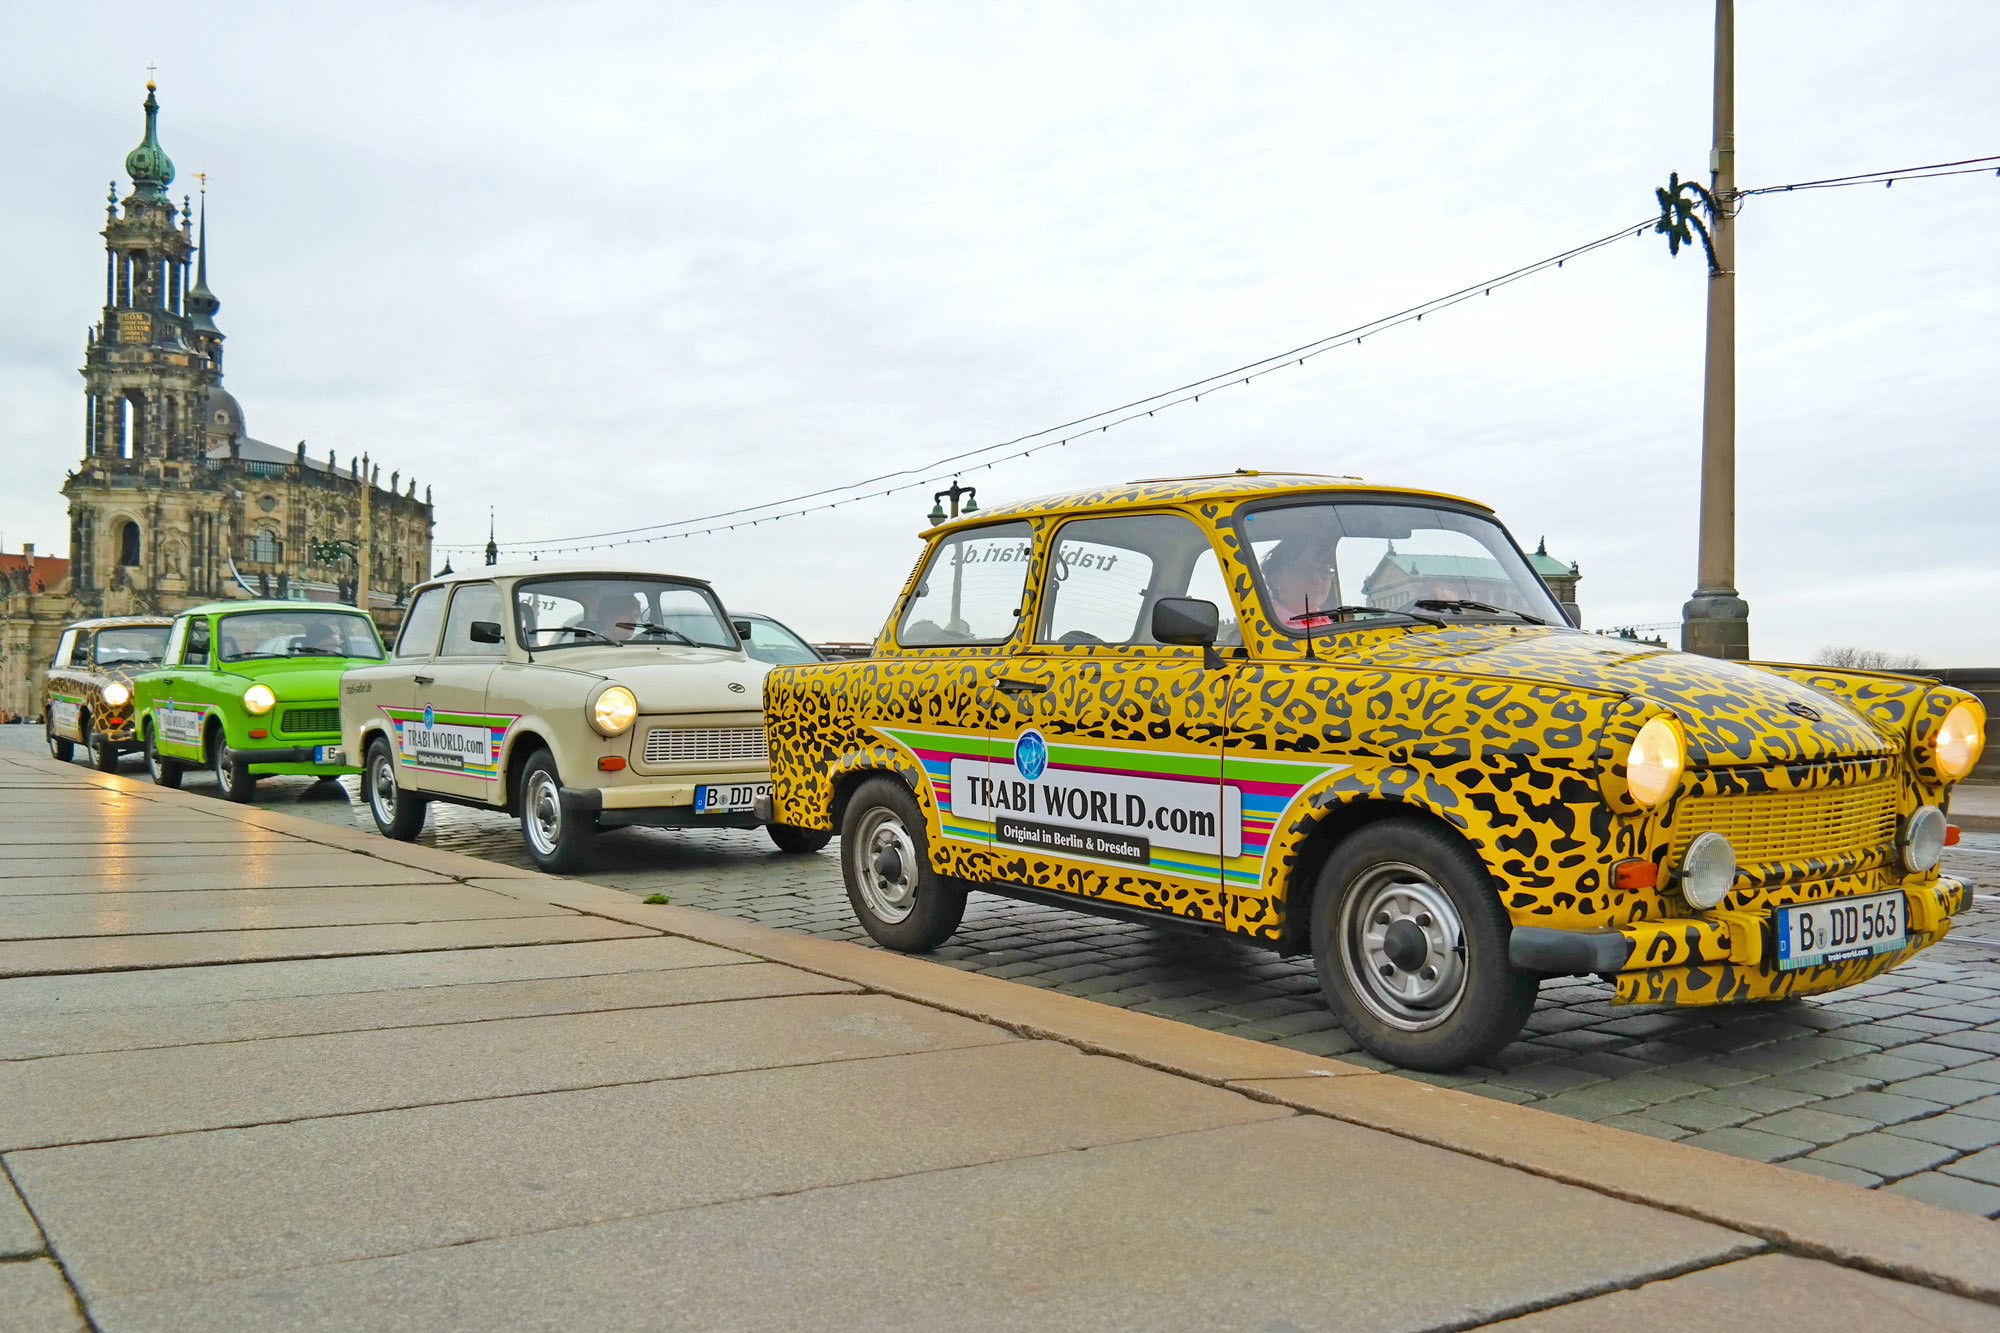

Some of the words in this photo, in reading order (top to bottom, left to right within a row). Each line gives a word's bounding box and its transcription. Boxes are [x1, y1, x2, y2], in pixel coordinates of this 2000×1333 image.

[407, 730, 431, 748] TRABI
[432, 732, 484, 754] WORLD.com
[706, 788, 718, 806] B
[729, 787, 753, 806] DD
[967, 775, 1035, 813] TRABI
[1042, 785, 1215, 838] WORLD.com
[1003, 824, 1040, 845] Original
[1042, 829, 1051, 844] in
[1053, 830, 1083, 849] Berlin
[1085, 837, 1095, 851] &
[1096, 838, 1141, 858] Dresden
[1799, 912, 1815, 952] B
[1830, 906, 1858, 947] DD
[1862, 899, 1897, 940] 563
[1780, 940, 1786, 952] D
